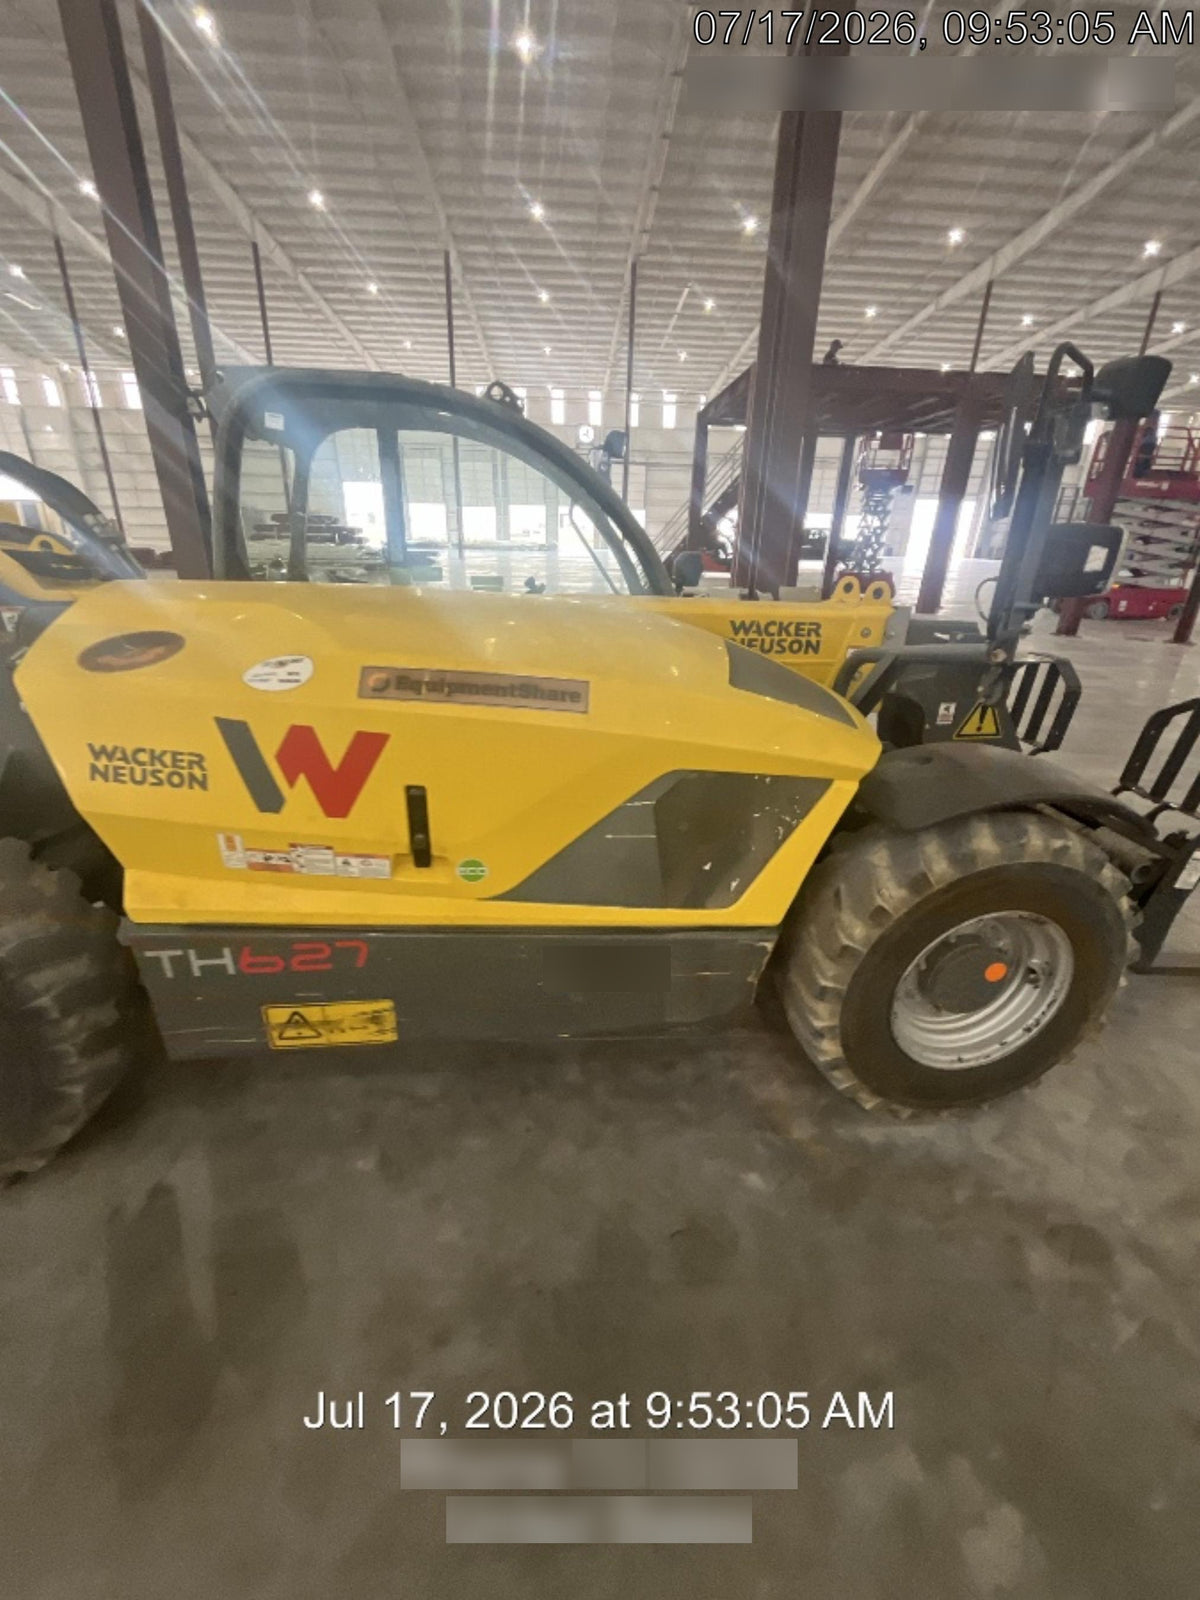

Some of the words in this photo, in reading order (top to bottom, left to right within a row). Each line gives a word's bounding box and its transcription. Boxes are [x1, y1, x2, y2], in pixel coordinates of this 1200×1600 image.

[729, 620, 822, 638] WACKER
[394, 674, 583, 704] EquipmentShare
[87, 742, 206, 772] WACKER
[89, 762, 208, 791] NEUSON
[144, 939, 370, 979] TH627
